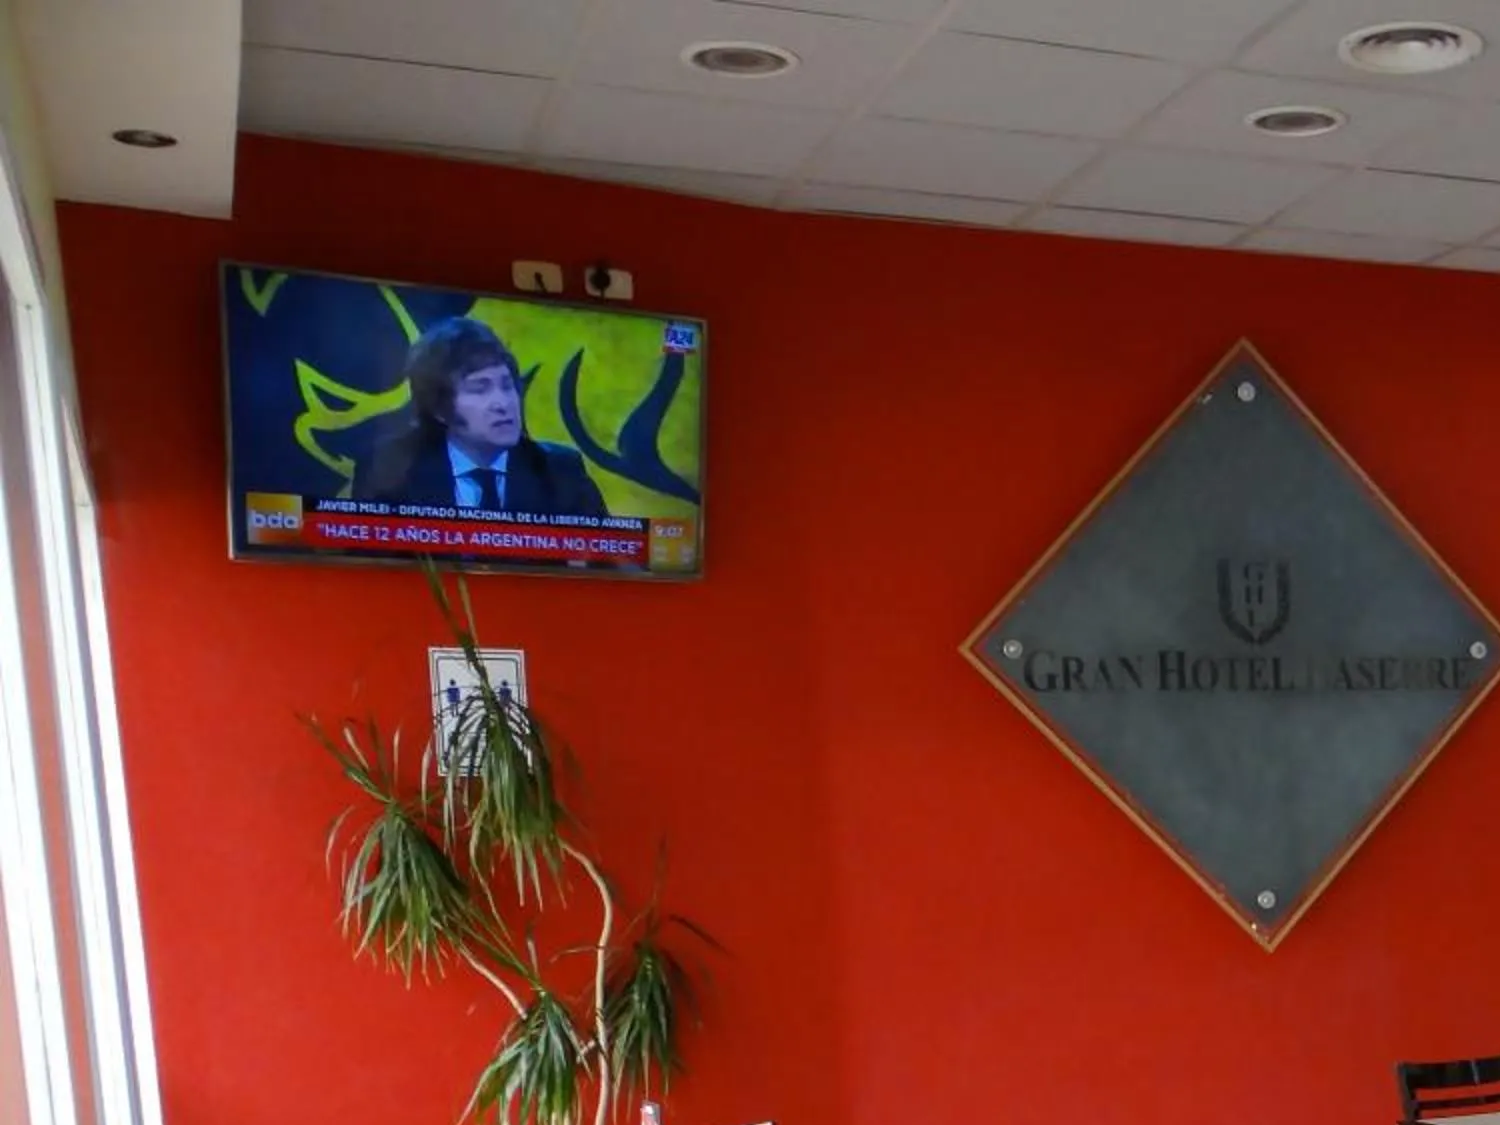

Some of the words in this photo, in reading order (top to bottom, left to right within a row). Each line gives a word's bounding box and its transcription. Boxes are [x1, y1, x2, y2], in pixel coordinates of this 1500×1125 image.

[316, 499, 357, 513] JAVIER
[359, 502, 390, 515] MILEI
[399, 504, 457, 518] DIPUTADO
[458, 508, 515, 523] NACIONAL
[517, 511, 532, 523] DE
[533, 513, 548, 525] LA
[550, 514, 599, 527] LIBERTAD
[602, 517, 643, 530] AVANZA
[374, 526, 390, 542] 12
[395, 525, 441, 544] AÑOS
[444, 531, 464, 545] LA
[469, 531, 560, 550] ARGENTINA
[562, 537, 586, 551] NO
[1023, 648, 1144, 692] GRAN
[1157, 649, 1296, 692] HOTEL
